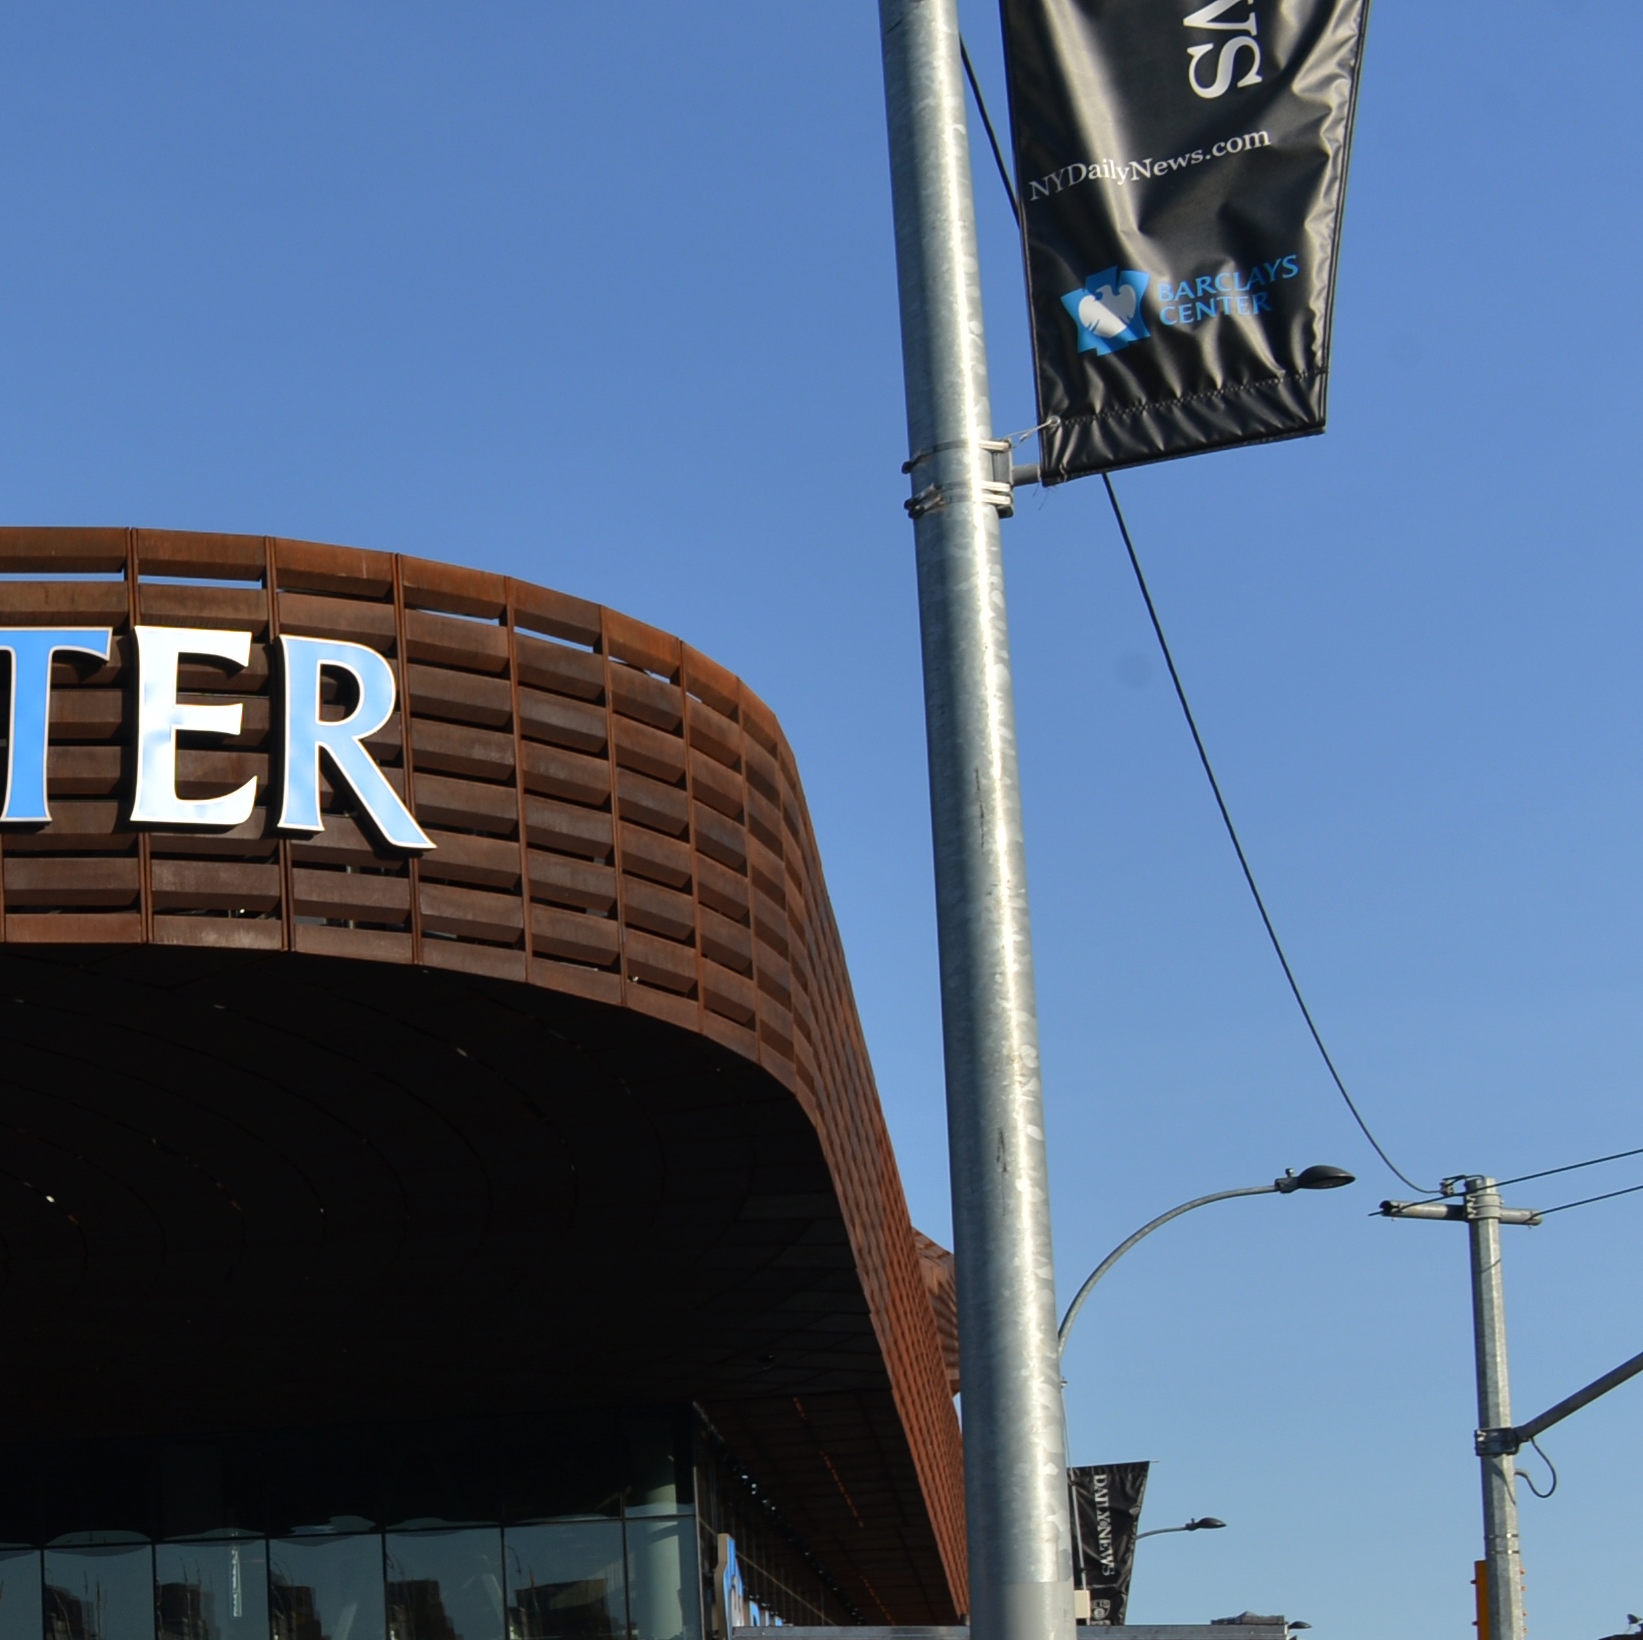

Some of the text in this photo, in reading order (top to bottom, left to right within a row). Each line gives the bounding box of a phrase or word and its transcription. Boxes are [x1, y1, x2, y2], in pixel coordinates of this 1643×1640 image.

[1029, 129, 1272, 201] NYDailyNews.com
[1156, 254, 1300, 302] BARCLAYS
[1159, 292, 1273, 326] CENTER
